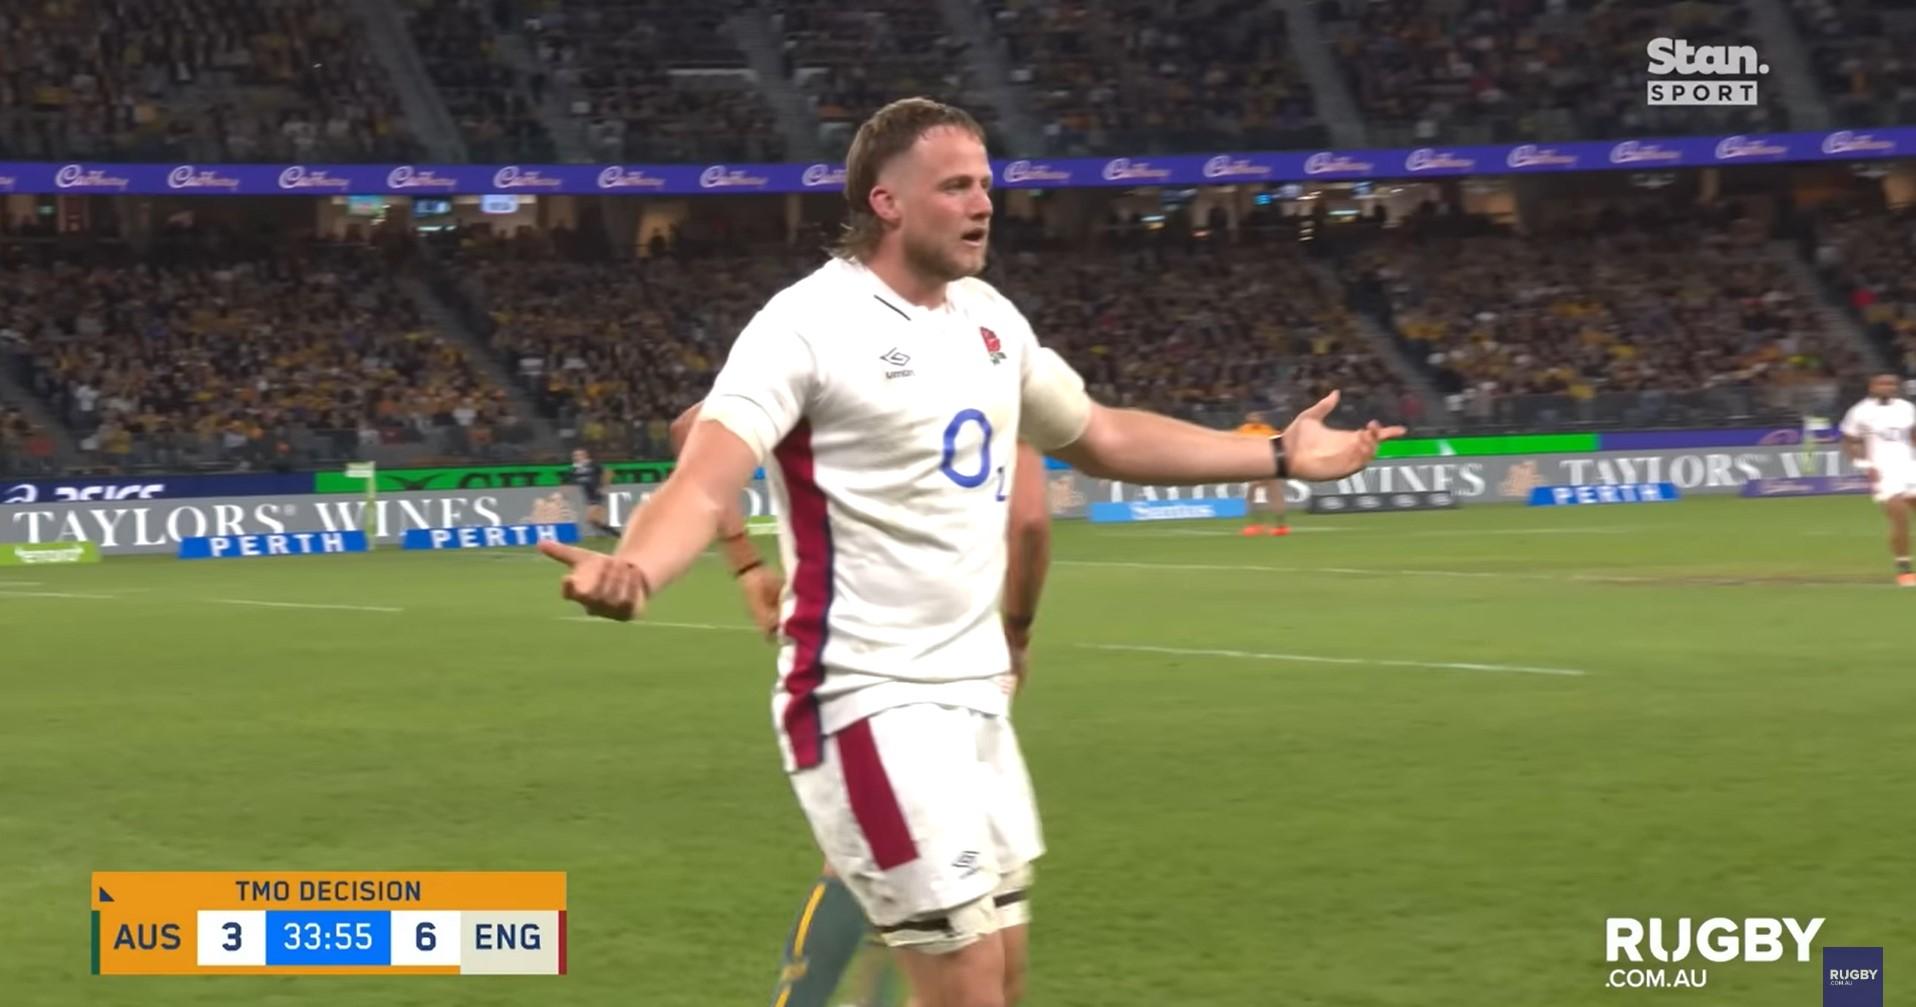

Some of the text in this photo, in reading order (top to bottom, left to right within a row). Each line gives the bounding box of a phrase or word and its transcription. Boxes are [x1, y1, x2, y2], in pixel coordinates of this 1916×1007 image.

[1553, 482, 1662, 504] PERTH
[313, 496, 501, 538] WINES
[209, 533, 345, 557] PERTH
[431, 526, 558, 549] PERTH
